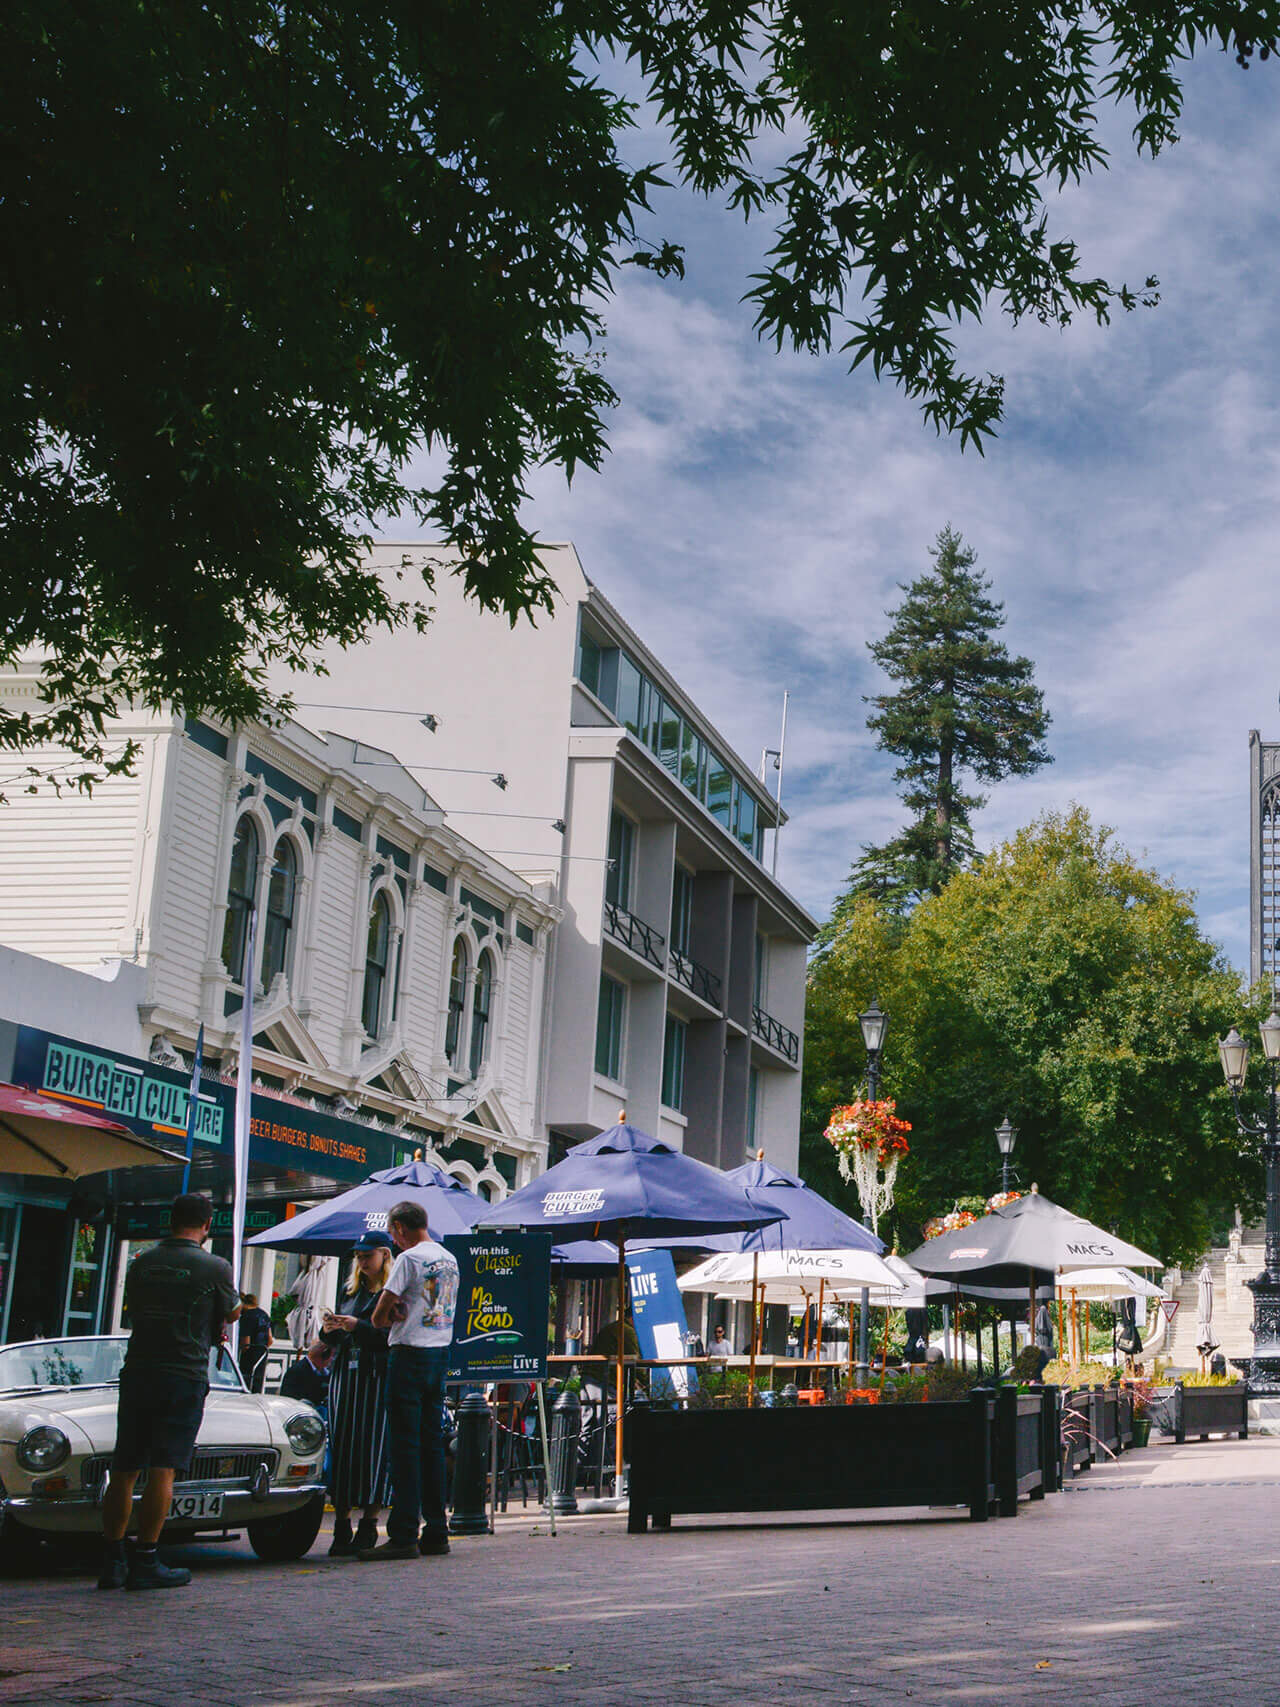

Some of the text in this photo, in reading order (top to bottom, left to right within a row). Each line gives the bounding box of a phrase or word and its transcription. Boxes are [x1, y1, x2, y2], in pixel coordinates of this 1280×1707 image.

[46, 1049, 137, 1114] BURGER
[545, 1201, 602, 1212] CULTURE
[469, 1246, 510, 1256] Win this
[474, 1253, 524, 1274] Classic
[494, 1267, 513, 1275] car.
[630, 1272, 659, 1298] LIVE
[482, 1304, 508, 1313] on the
[466, 1309, 513, 1336] ROAD
[513, 1358, 539, 1370] LIVE
[170, 1497, 221, 1517] K914
